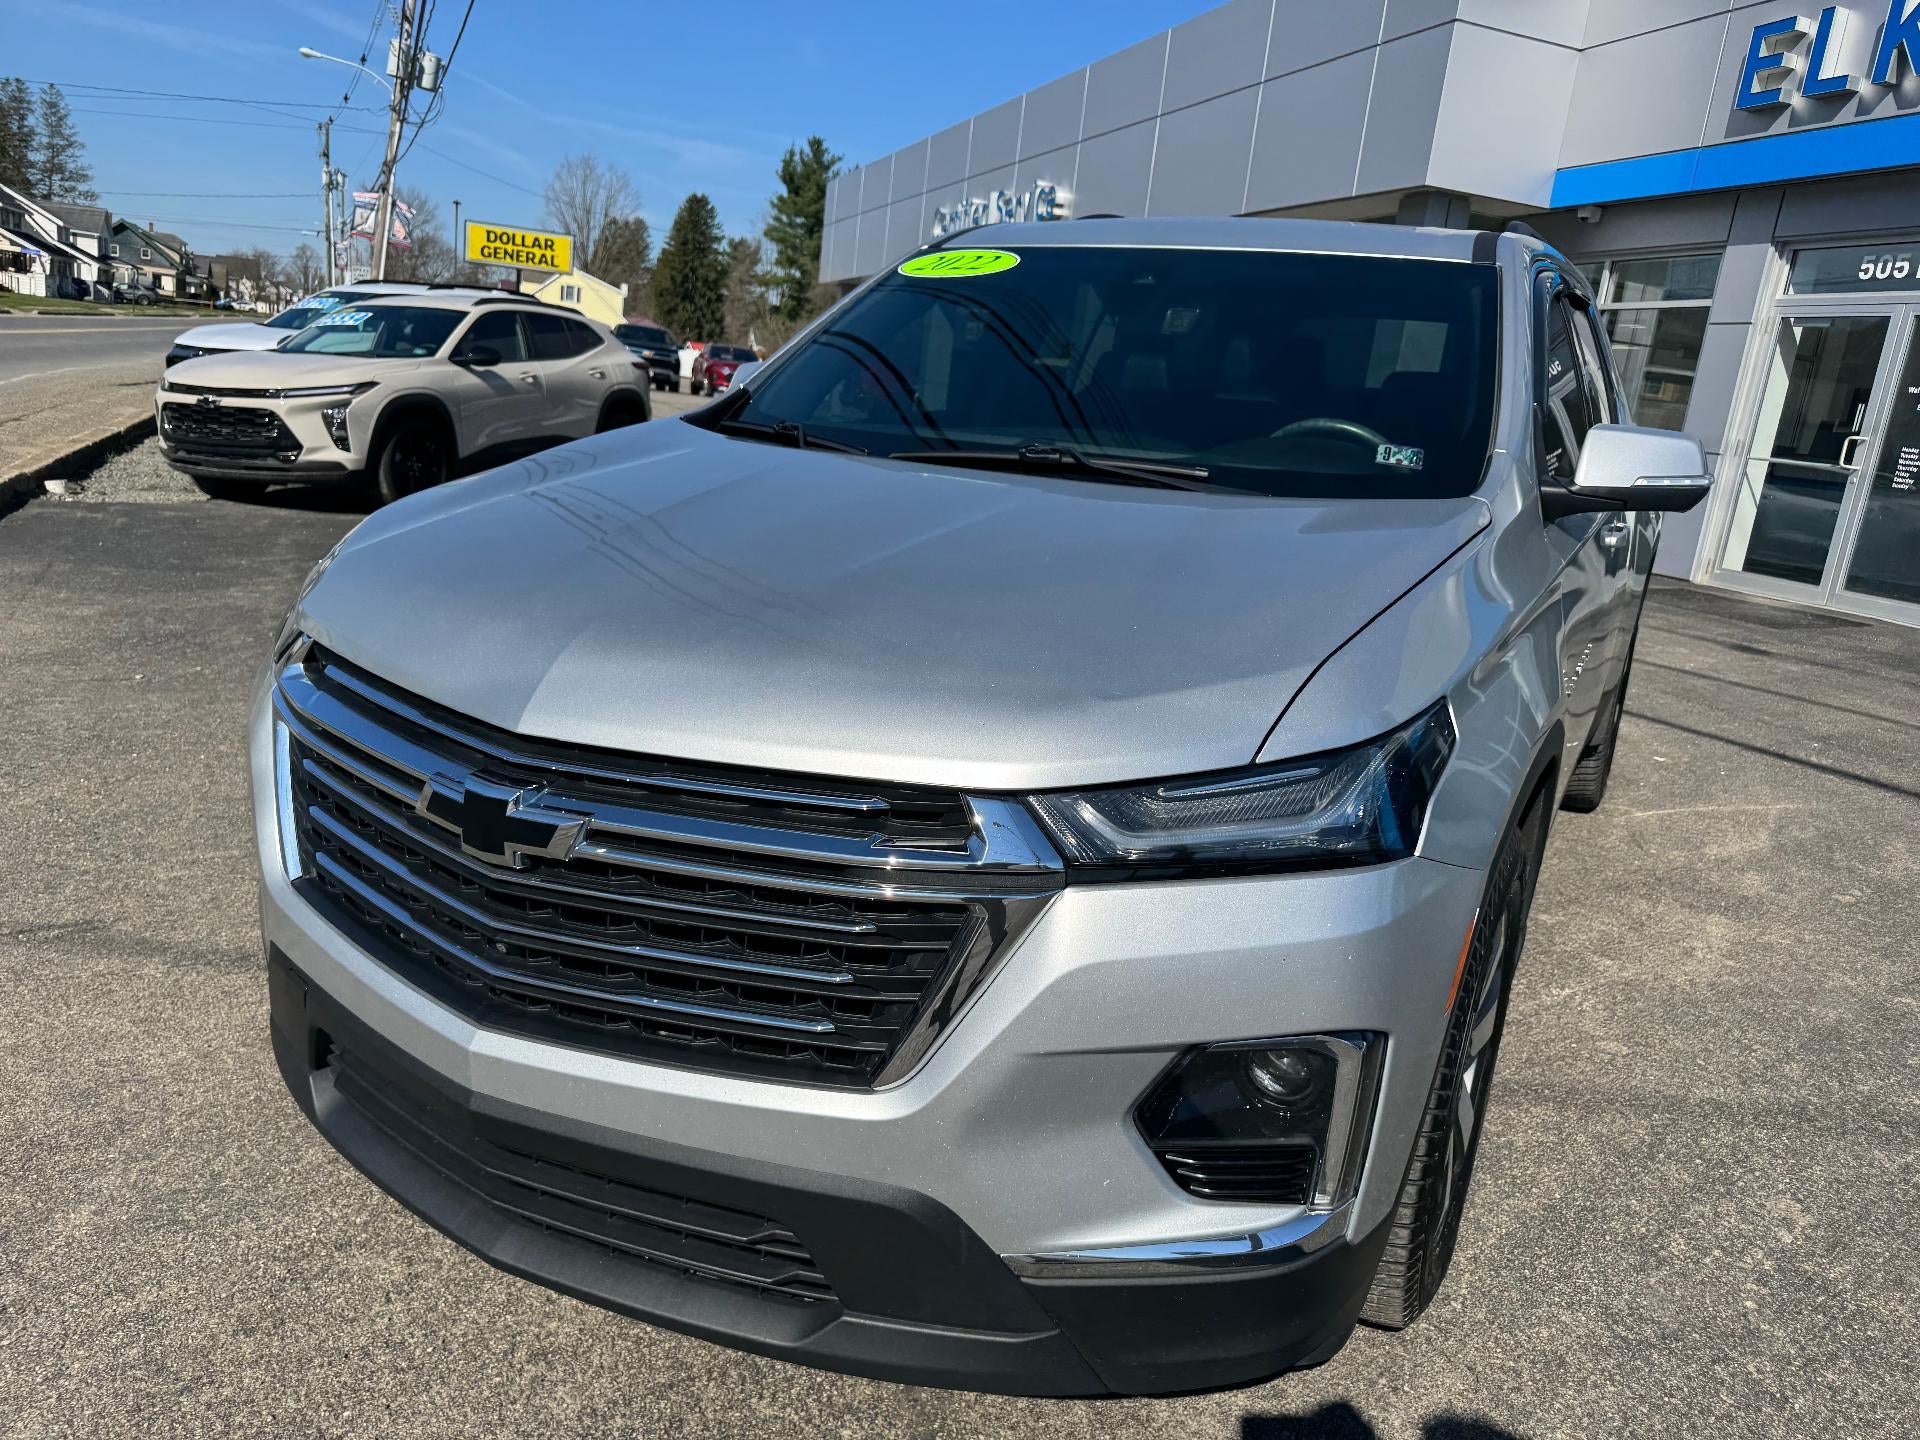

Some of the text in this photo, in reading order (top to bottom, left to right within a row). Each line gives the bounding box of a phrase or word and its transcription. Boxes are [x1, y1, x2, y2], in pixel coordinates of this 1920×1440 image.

[485, 229, 555, 252] DOLLAR
[480, 245, 560, 268] GENERAL
[911, 255, 1002, 271] 2022
[1858, 253, 1912, 280] 505
[1901, 446, 1919, 454] Monday
[1900, 452, 1918, 460] Tuesday
[1897, 464, 1918, 473] Thursday
[1894, 470, 1910, 478] Friday
[1893, 476, 1914, 485] Saturday
